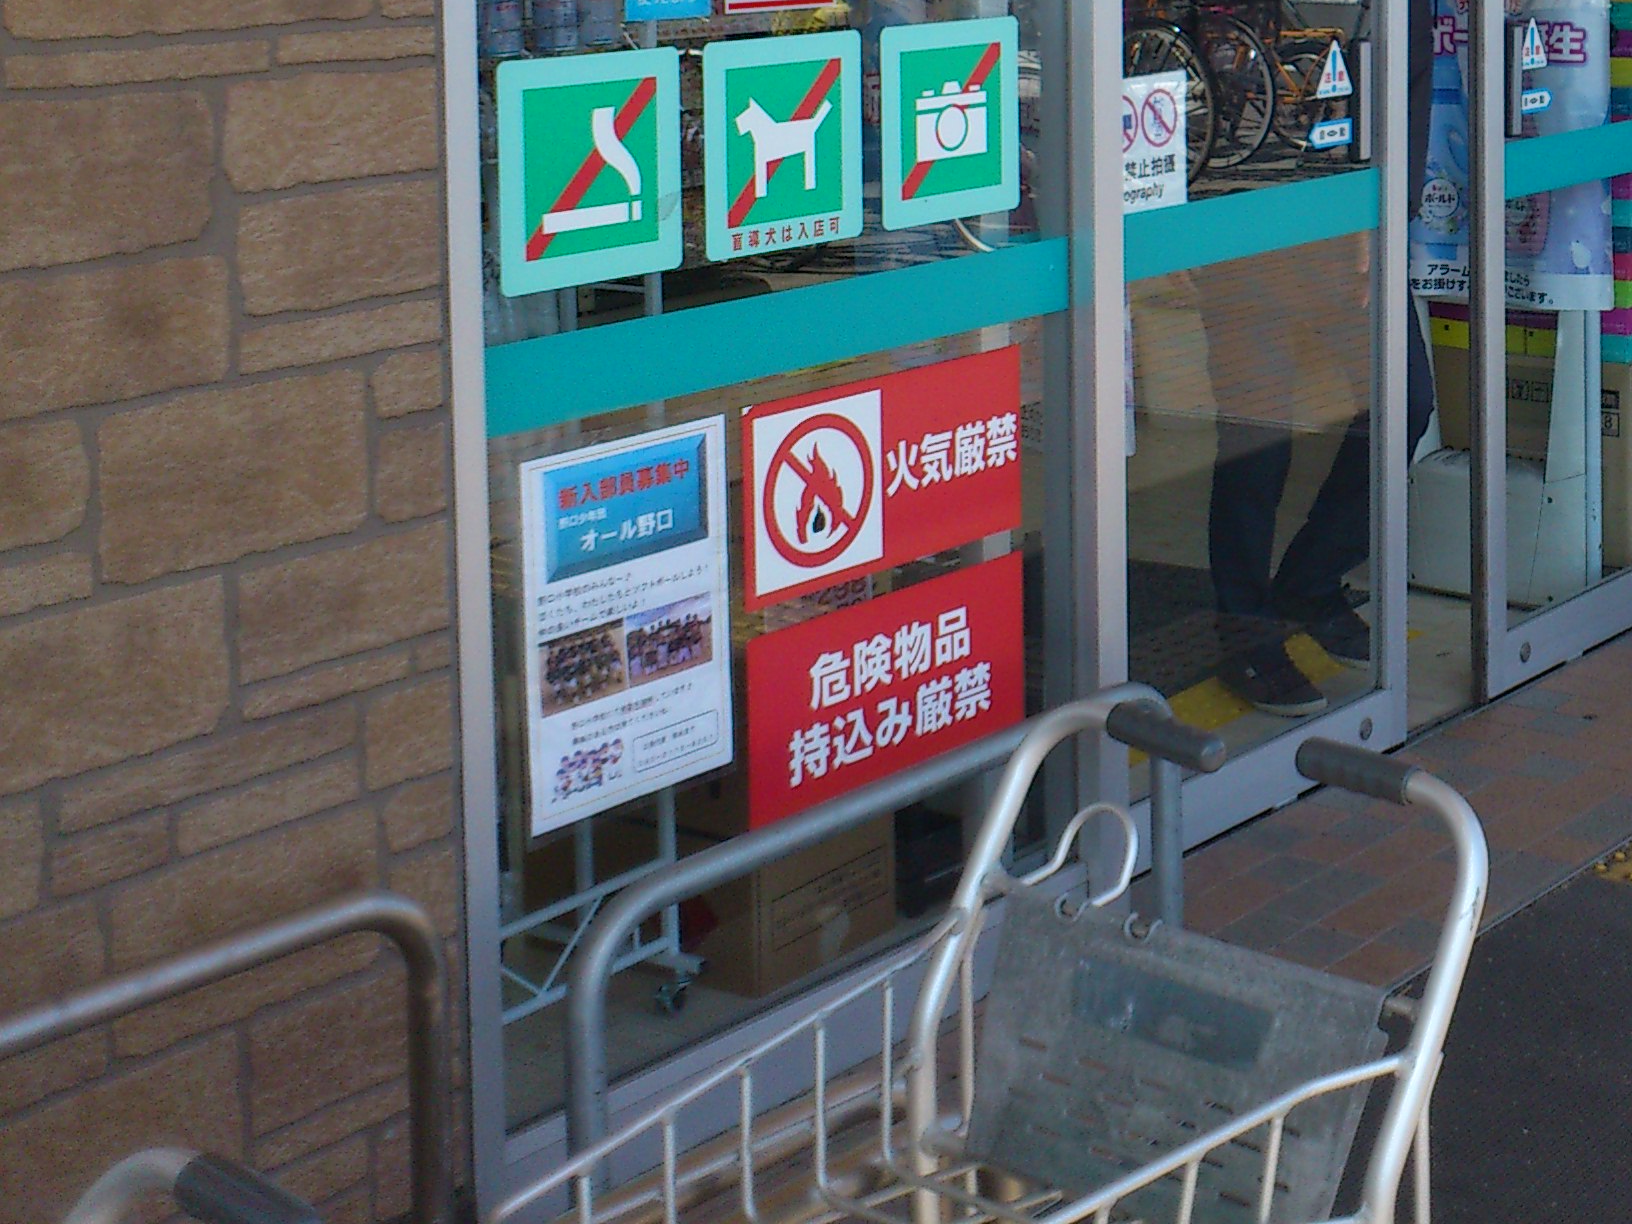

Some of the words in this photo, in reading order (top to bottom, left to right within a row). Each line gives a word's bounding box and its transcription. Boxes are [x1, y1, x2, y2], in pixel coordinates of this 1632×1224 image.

[731, 217, 840, 251] 盲導犬は入店可
[1411, 278, 1470, 291] をお掛けす
[886, 412, 1018, 497] 火気厳禁
[580, 509, 673, 552] オール野口
[809, 605, 971, 711] 危険物品
[787, 661, 991, 788] 持込み厳禁
